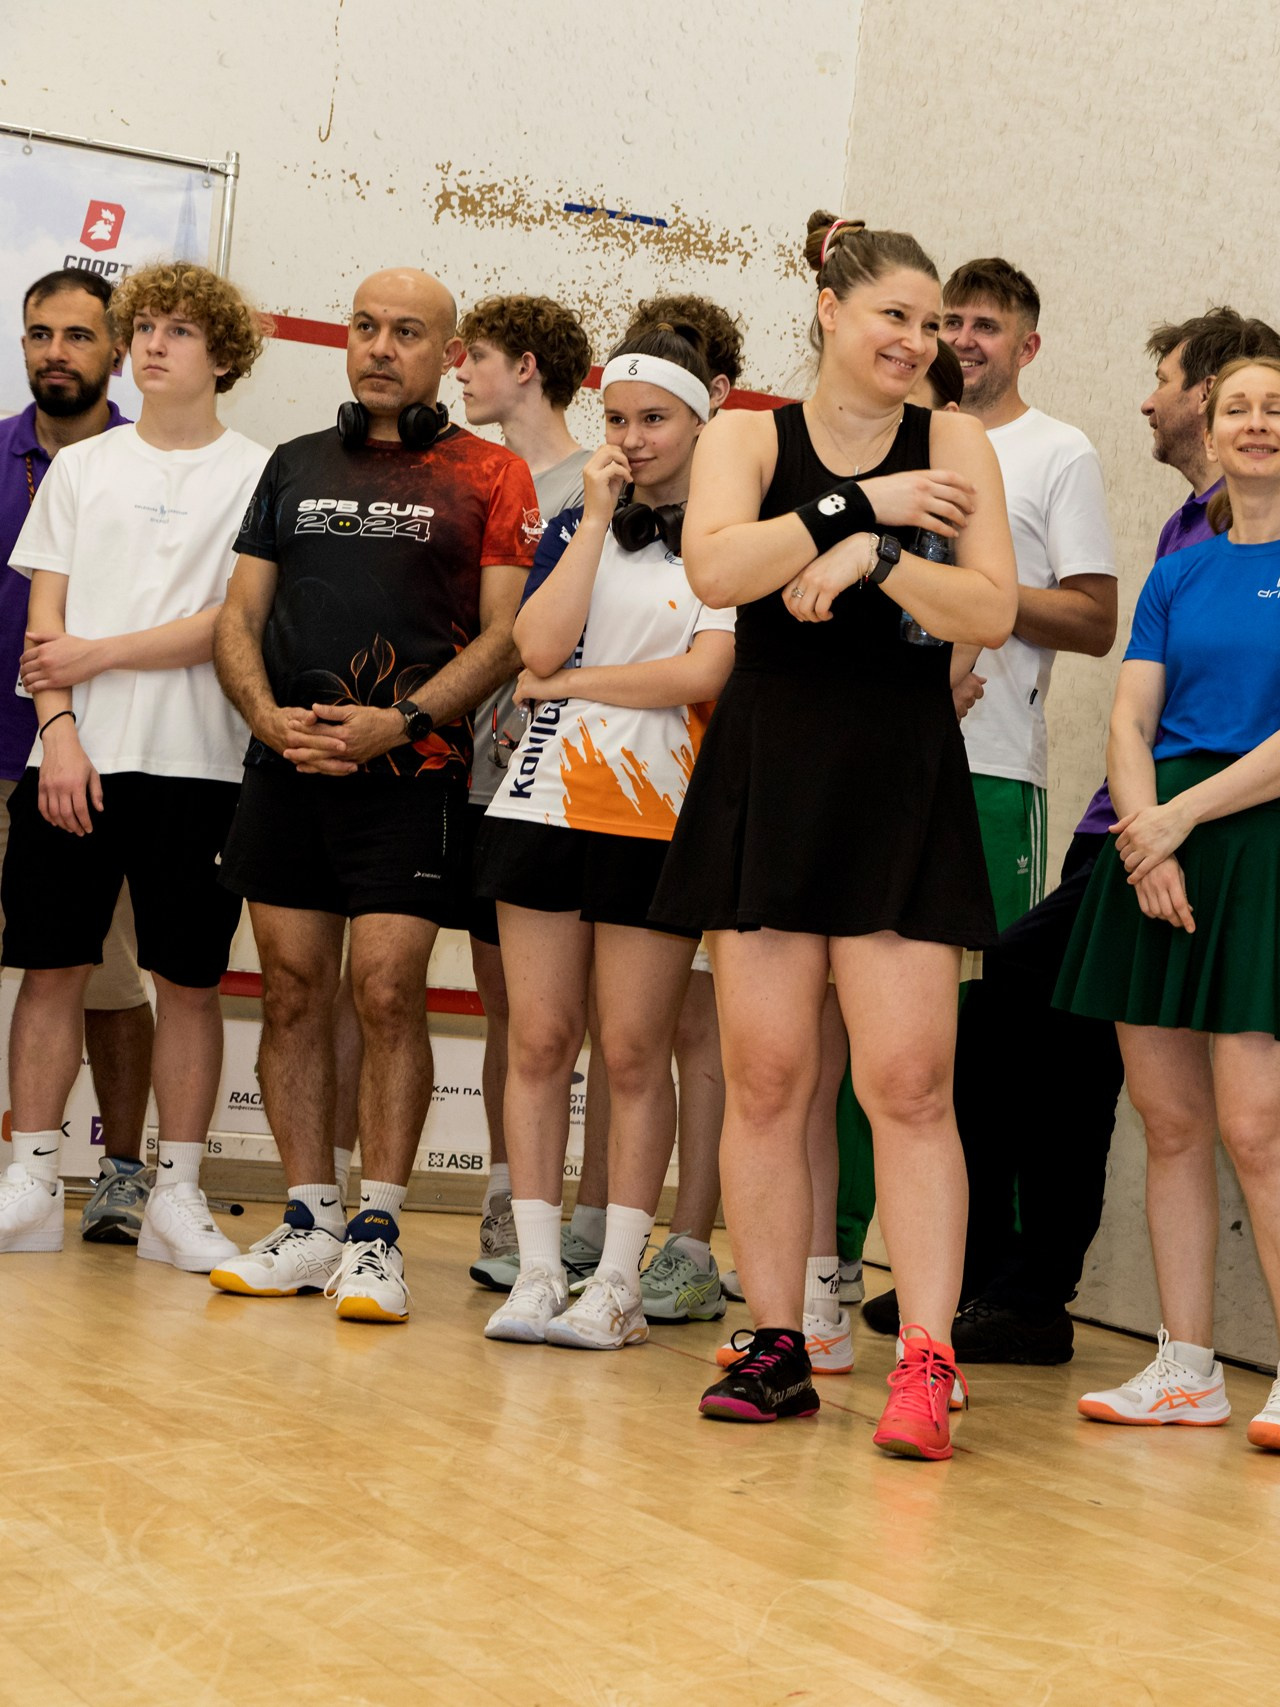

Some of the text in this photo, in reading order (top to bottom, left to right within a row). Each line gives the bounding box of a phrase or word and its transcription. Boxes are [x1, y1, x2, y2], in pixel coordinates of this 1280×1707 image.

[297, 499, 435, 518] SPB CUP
[294, 511, 431, 543] 2024
[446, 1153, 484, 1170] ASB
